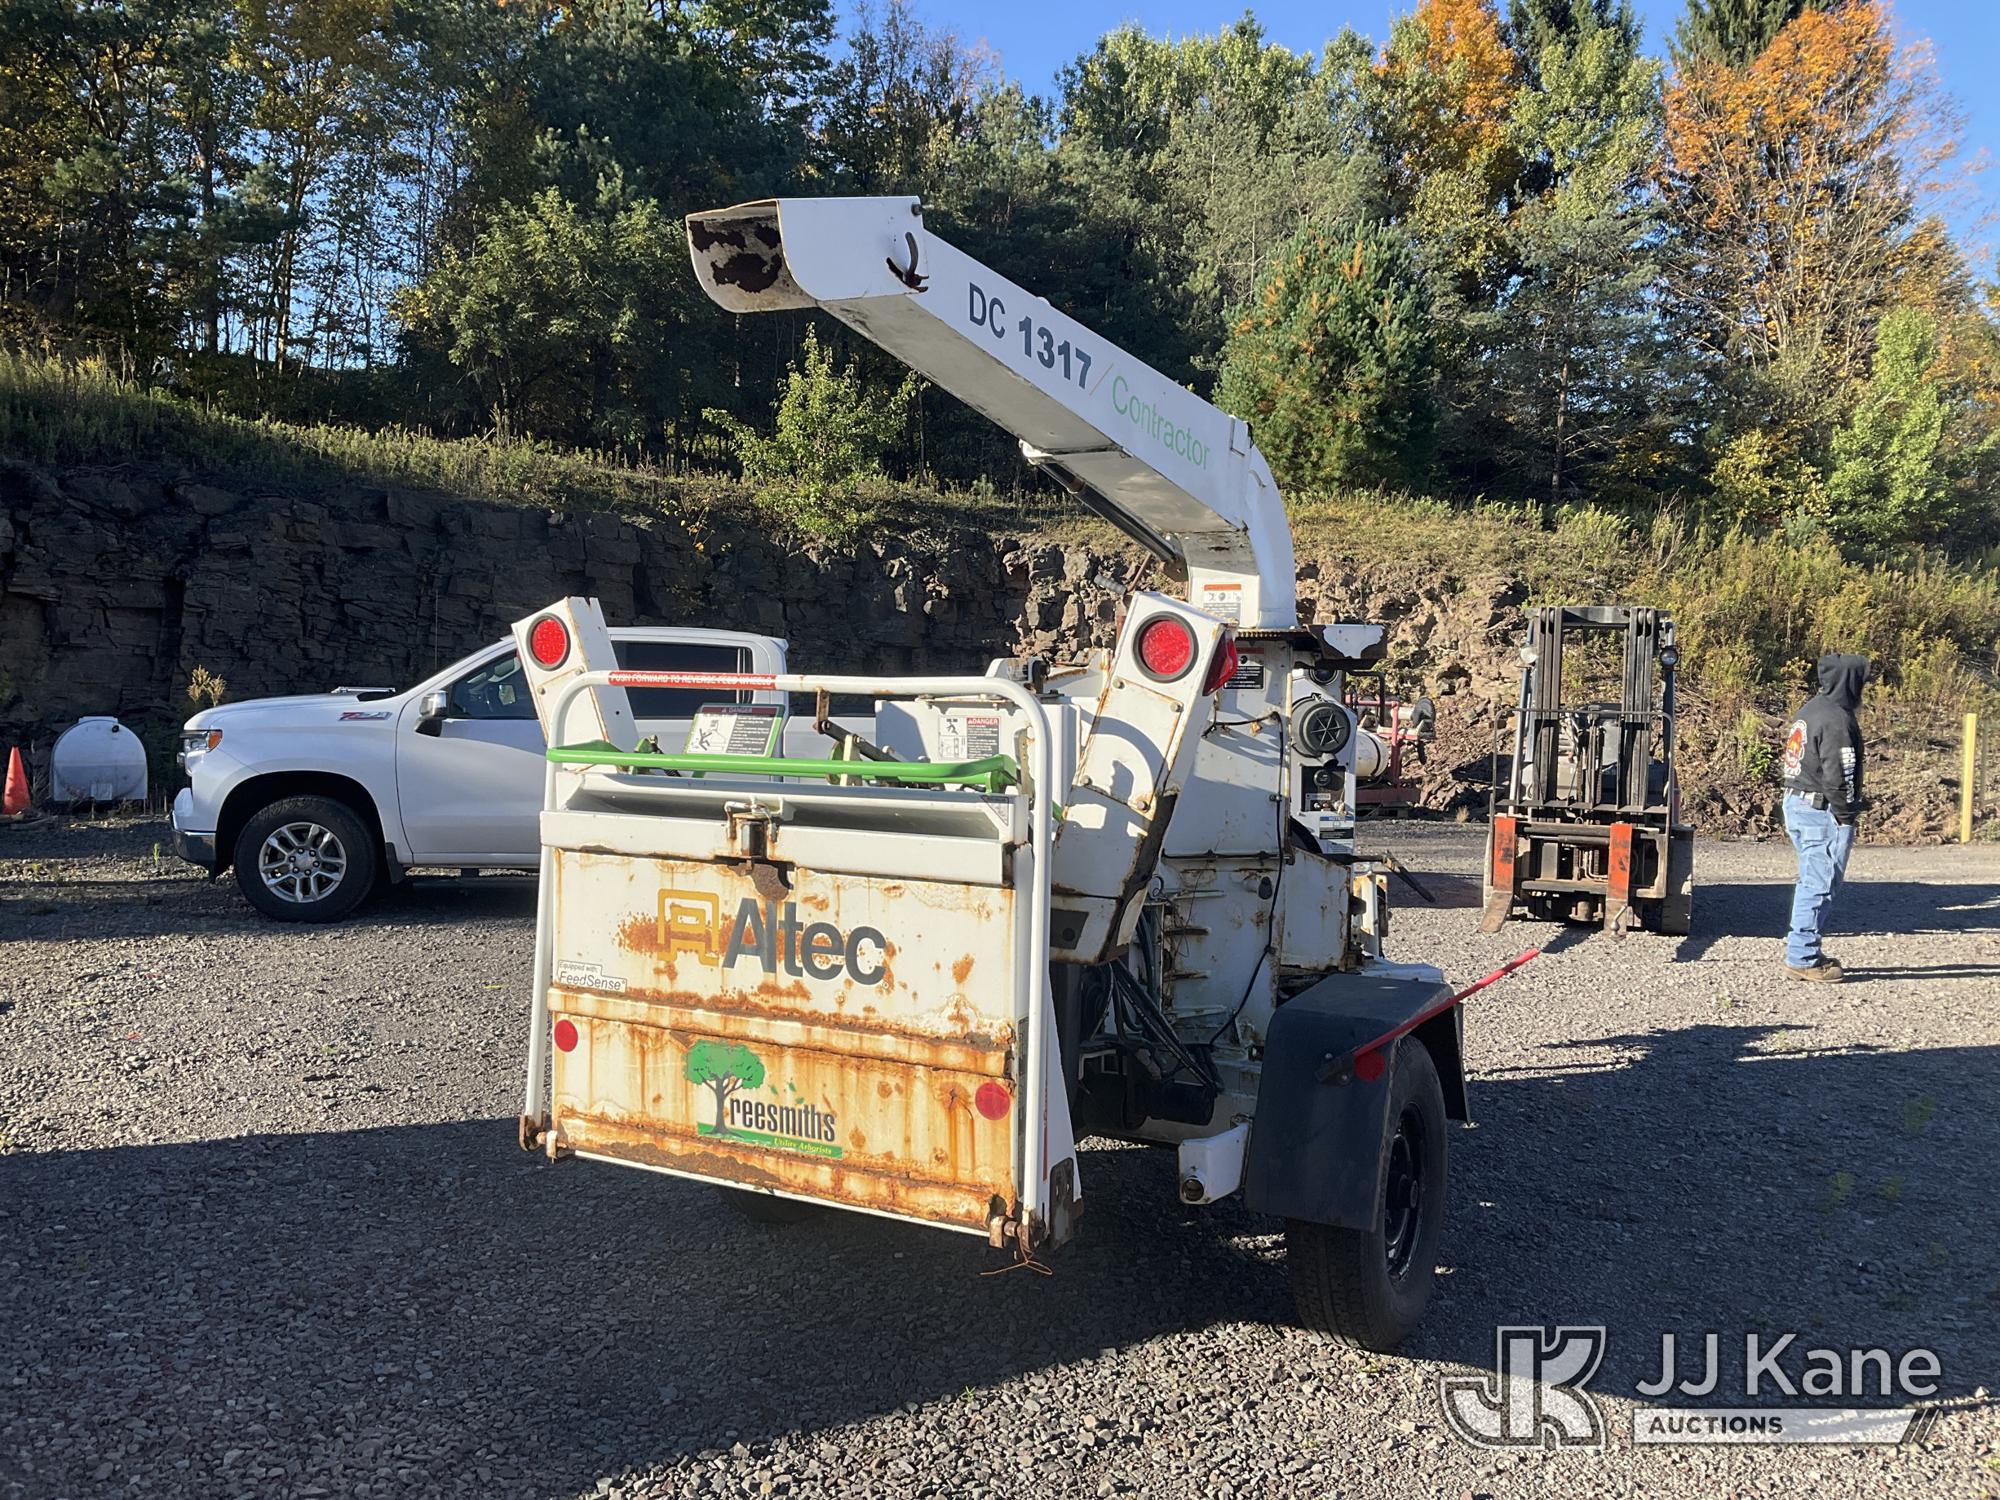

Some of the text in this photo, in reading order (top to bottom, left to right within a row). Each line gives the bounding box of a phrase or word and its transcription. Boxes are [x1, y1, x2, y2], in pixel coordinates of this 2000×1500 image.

[970, 282, 1210, 470] DC 1317 Contractor
[722, 897, 887, 986] Altec
